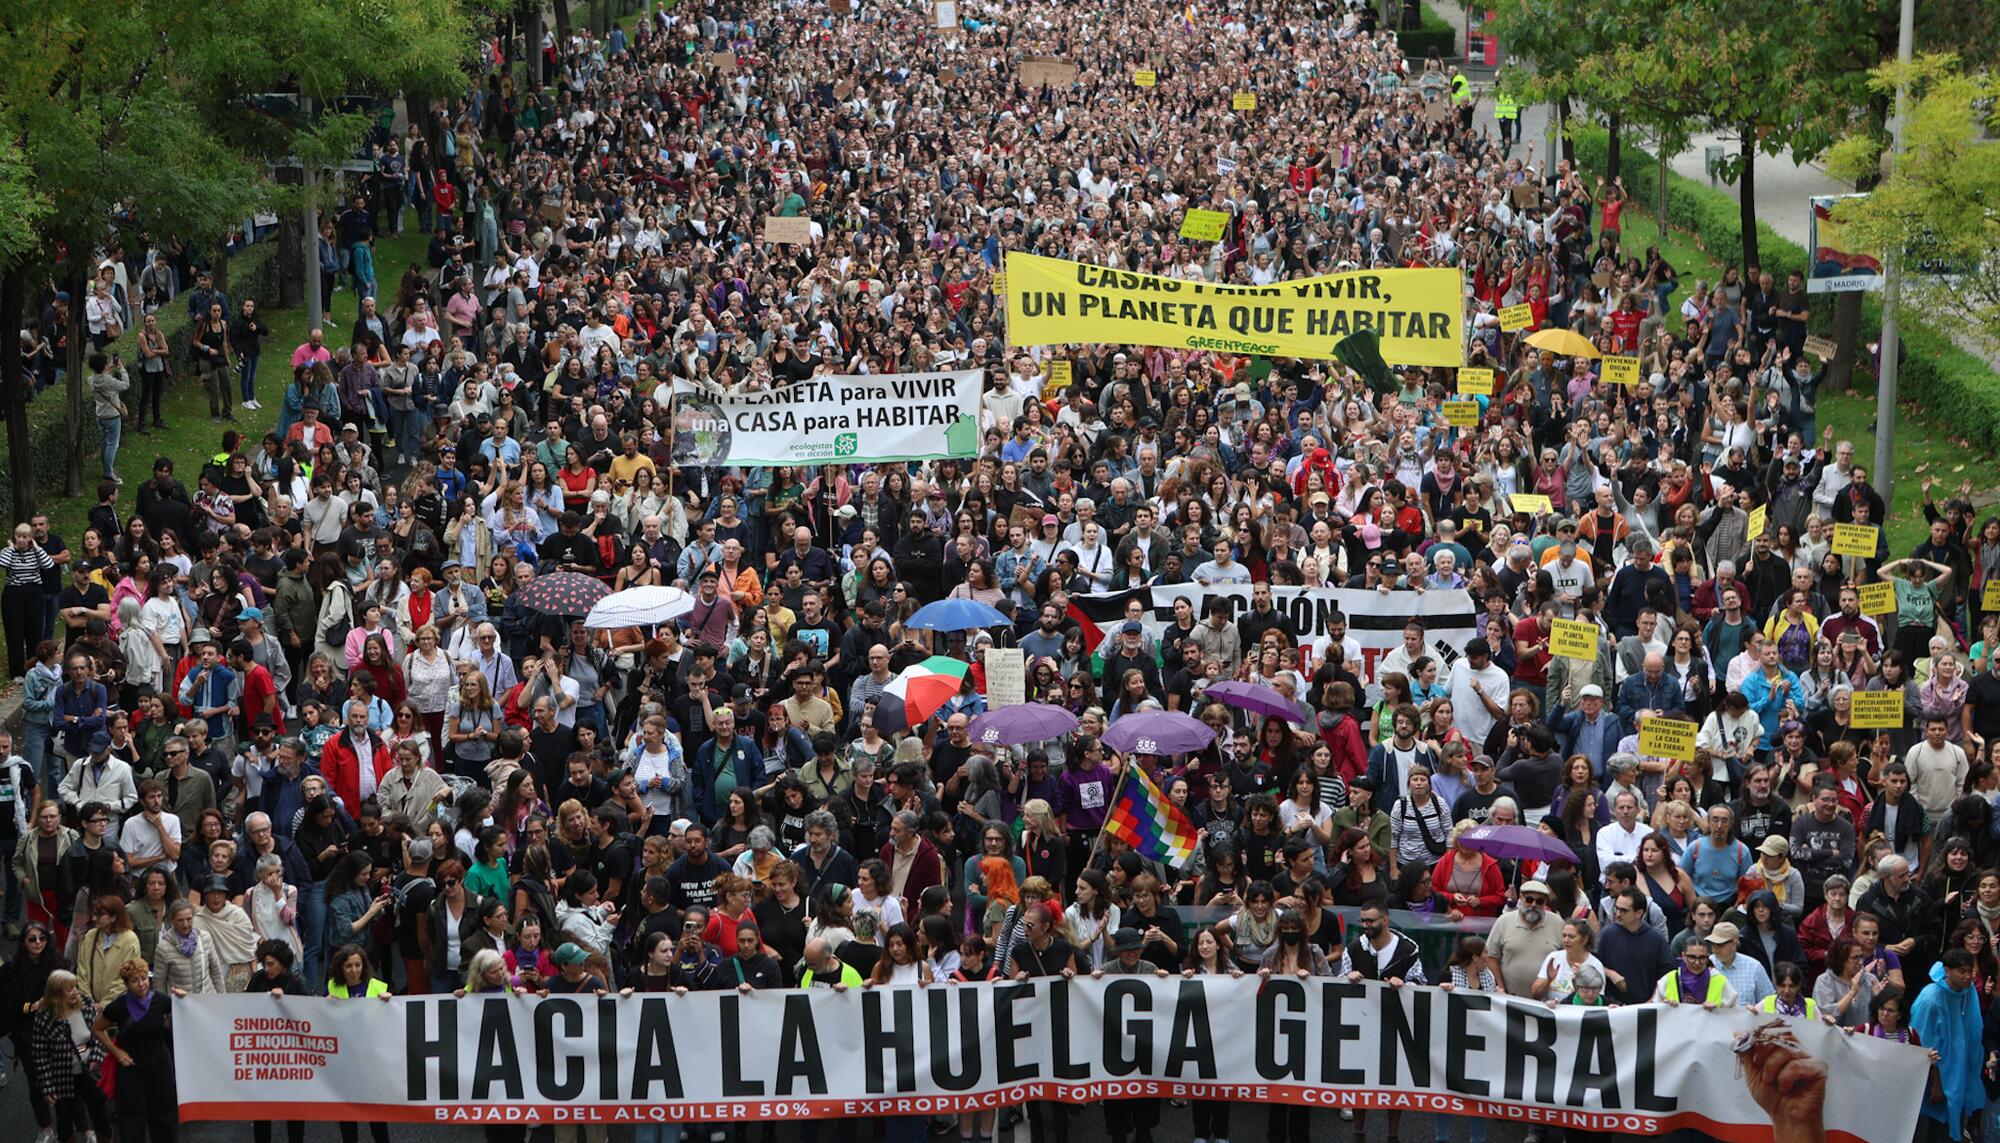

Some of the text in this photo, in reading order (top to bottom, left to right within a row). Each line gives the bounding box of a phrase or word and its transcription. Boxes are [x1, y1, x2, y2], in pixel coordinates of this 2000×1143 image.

[1833, 280, 1866, 289] MADRID
[1022, 292, 1451, 339] UN PLANETA QUE HABITAR
[1186, 335, 1280, 354] GREENPEACE
[841, 386, 886, 405] para
[891, 378, 956, 399] VIVIR
[691, 405, 960, 434] una CASA para HABITAR
[790, 443, 833, 452] ecologistas
[1650, 719, 1690, 730] DEFENDAMOS
[681, 882, 699, 890] NEW
[234, 1018, 311, 1033] SINDICATO
[234, 1036, 335, 1053] DE INQUILINAS
[406, 978, 1678, 1112] HACIA LA HUELGA GENERAL
[234, 1053, 327, 1067] E INQUILINOS
[234, 1067, 314, 1081] DE MADRID
[435, 1106, 541, 1121] BAJADA
[554, 1106, 603, 1121] DEL
[614, 1104, 747, 1120] ALQUILER
[760, 1102, 810, 1118] 50%
[844, 1083, 1043, 1115] EXPROPIACIÓN
[1057, 1081, 1158, 1100] FONDOS
[1172, 1083, 1269, 1100] BUITRE
[1302, 1089, 1466, 1113] CONTRATOS
[1477, 1101, 1659, 1133] INDEFINIDOS
